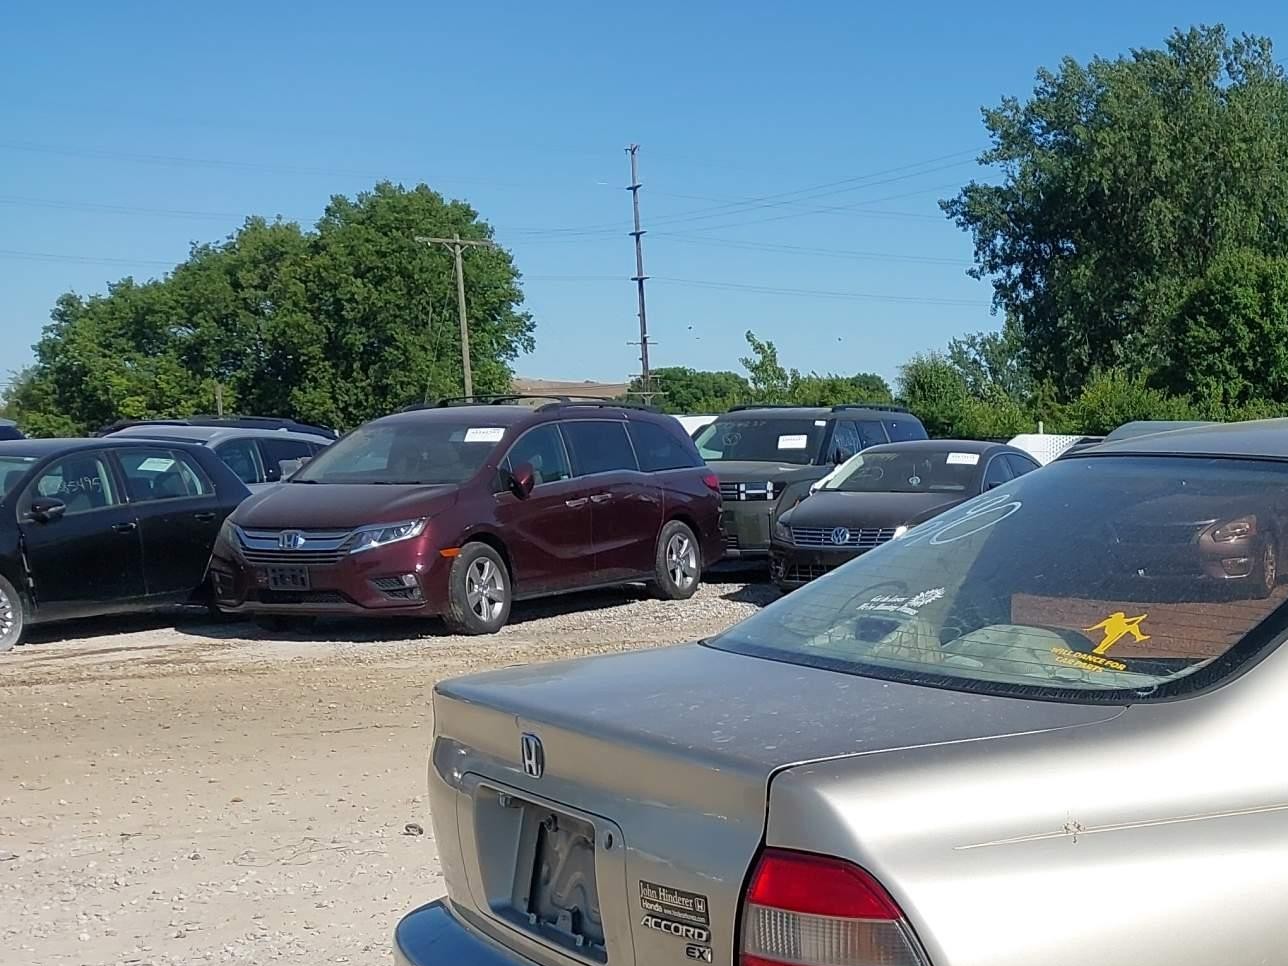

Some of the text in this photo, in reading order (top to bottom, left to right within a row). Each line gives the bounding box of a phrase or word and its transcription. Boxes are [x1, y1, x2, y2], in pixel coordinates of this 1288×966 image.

[1056, 656, 1106, 673] CAR PARTS
[1073, 651, 1106, 665] DANCE
[1104, 660, 1127, 671] FOR
[640, 882, 657, 899] John
[658, 887, 693, 908] Hinderer
[642, 899, 663, 913] Honda
[641, 915, 707, 941] ACCORD
[686, 946, 706, 961] EX
